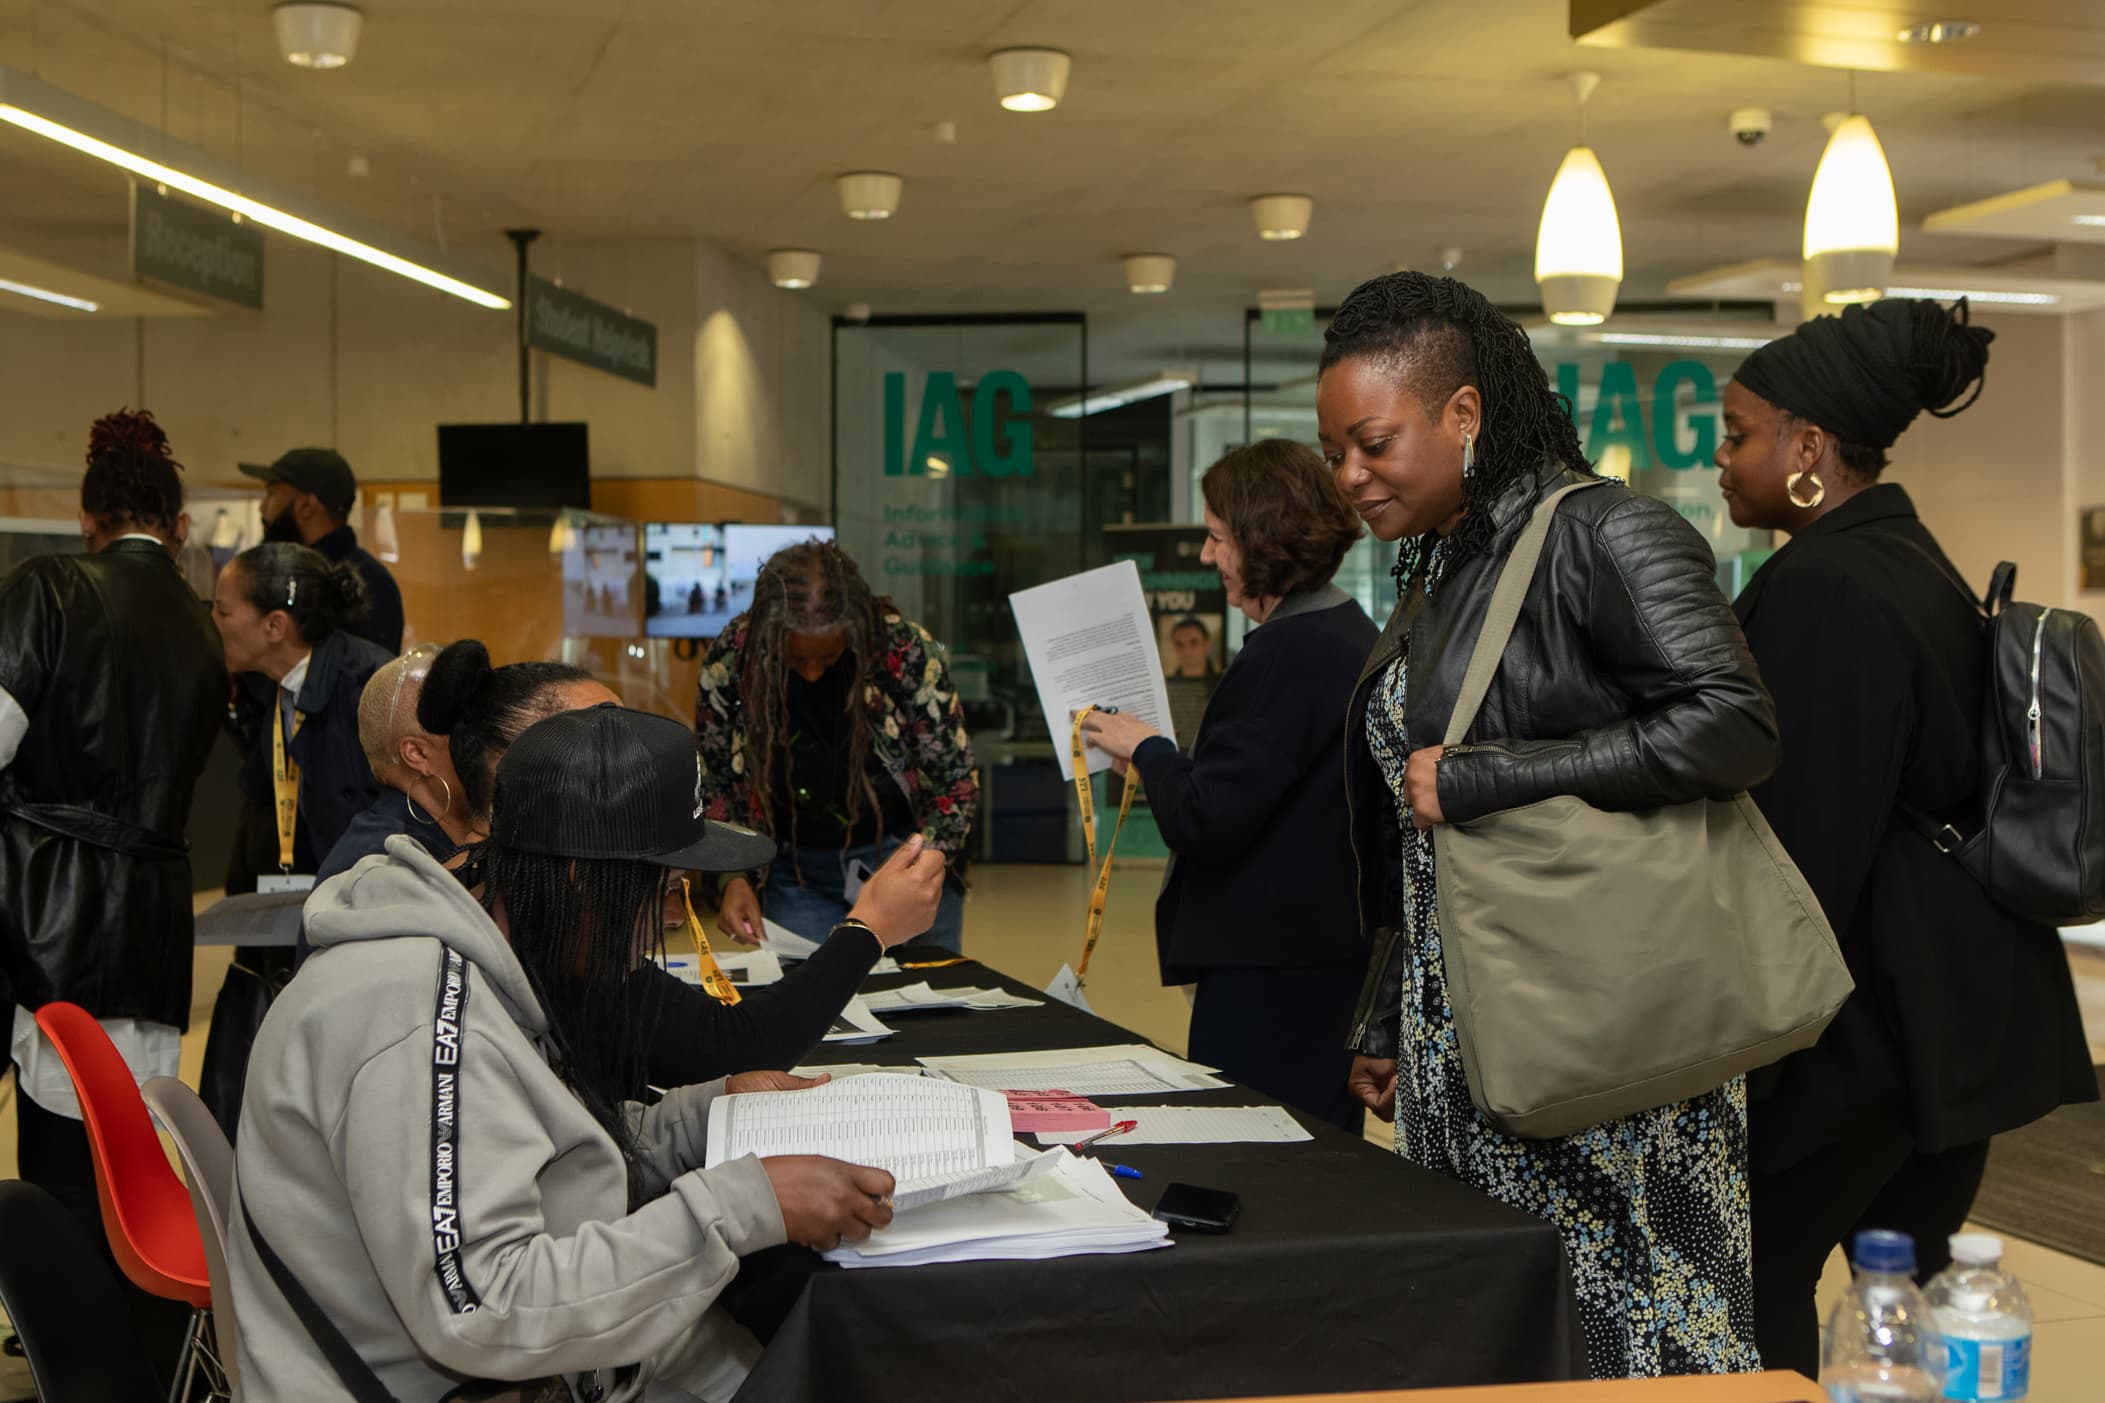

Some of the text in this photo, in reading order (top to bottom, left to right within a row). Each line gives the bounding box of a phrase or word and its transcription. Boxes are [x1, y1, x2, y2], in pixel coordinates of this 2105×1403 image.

[884, 370, 1034, 477] IAG
[1157, 591, 1196, 611] YOU
[435, 1018, 459, 1065] EA7
[437, 1073, 454, 1126] ARMANI
[436, 1142, 453, 1206] EMPORIO
[433, 1206, 460, 1255] EA7
